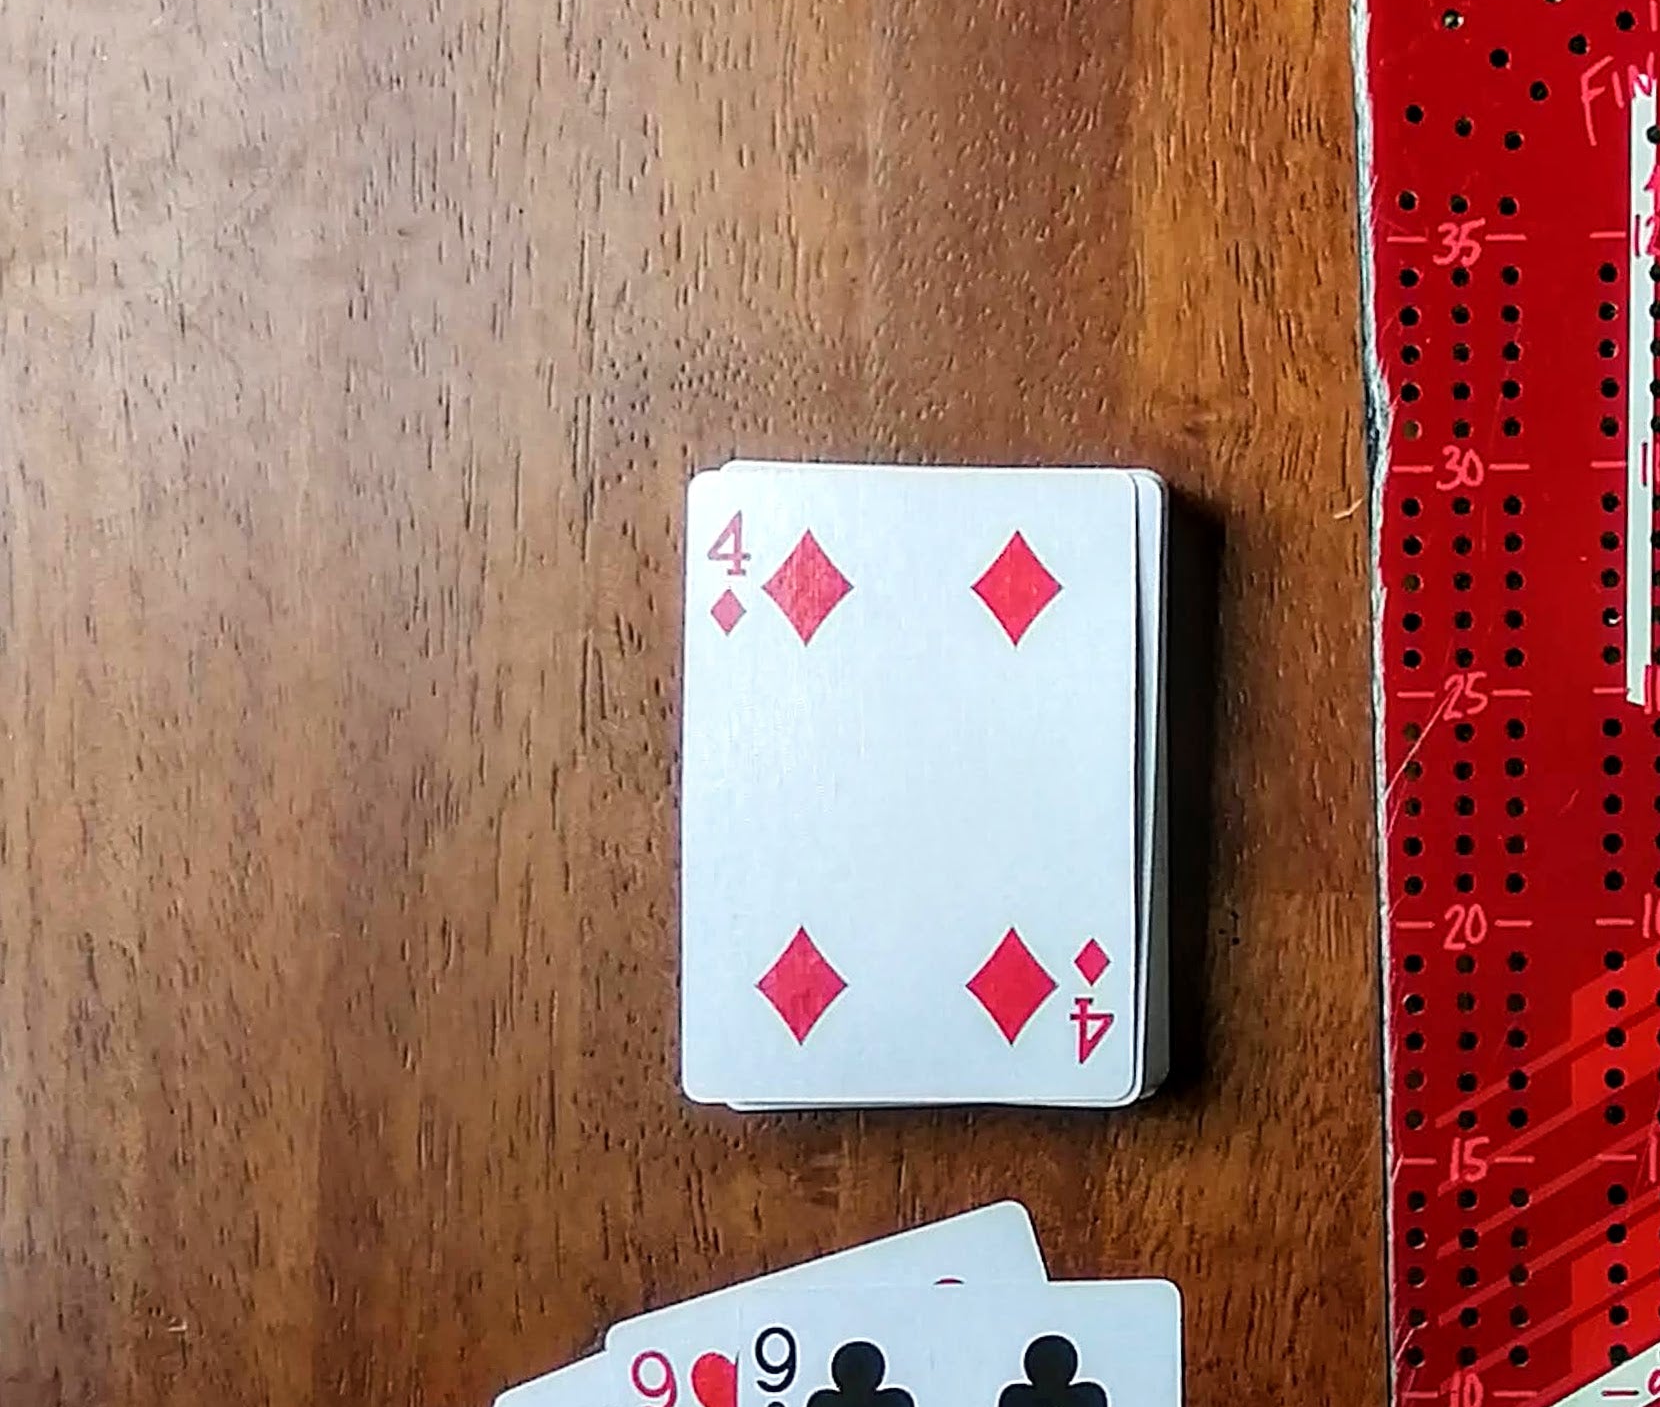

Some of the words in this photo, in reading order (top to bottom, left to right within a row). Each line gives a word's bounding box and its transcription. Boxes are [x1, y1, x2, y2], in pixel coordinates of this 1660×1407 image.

[1433, 218, 1485, 266] 35
[1436, 446, 1485, 492] 30
[707, 510, 751, 576] 4
[1442, 671, 1488, 720] 25
[1444, 903, 1488, 951] 20
[1069, 997, 1115, 1065] 4
[1449, 1136, 1490, 1183] 15
[754, 1326, 797, 1392] 9
